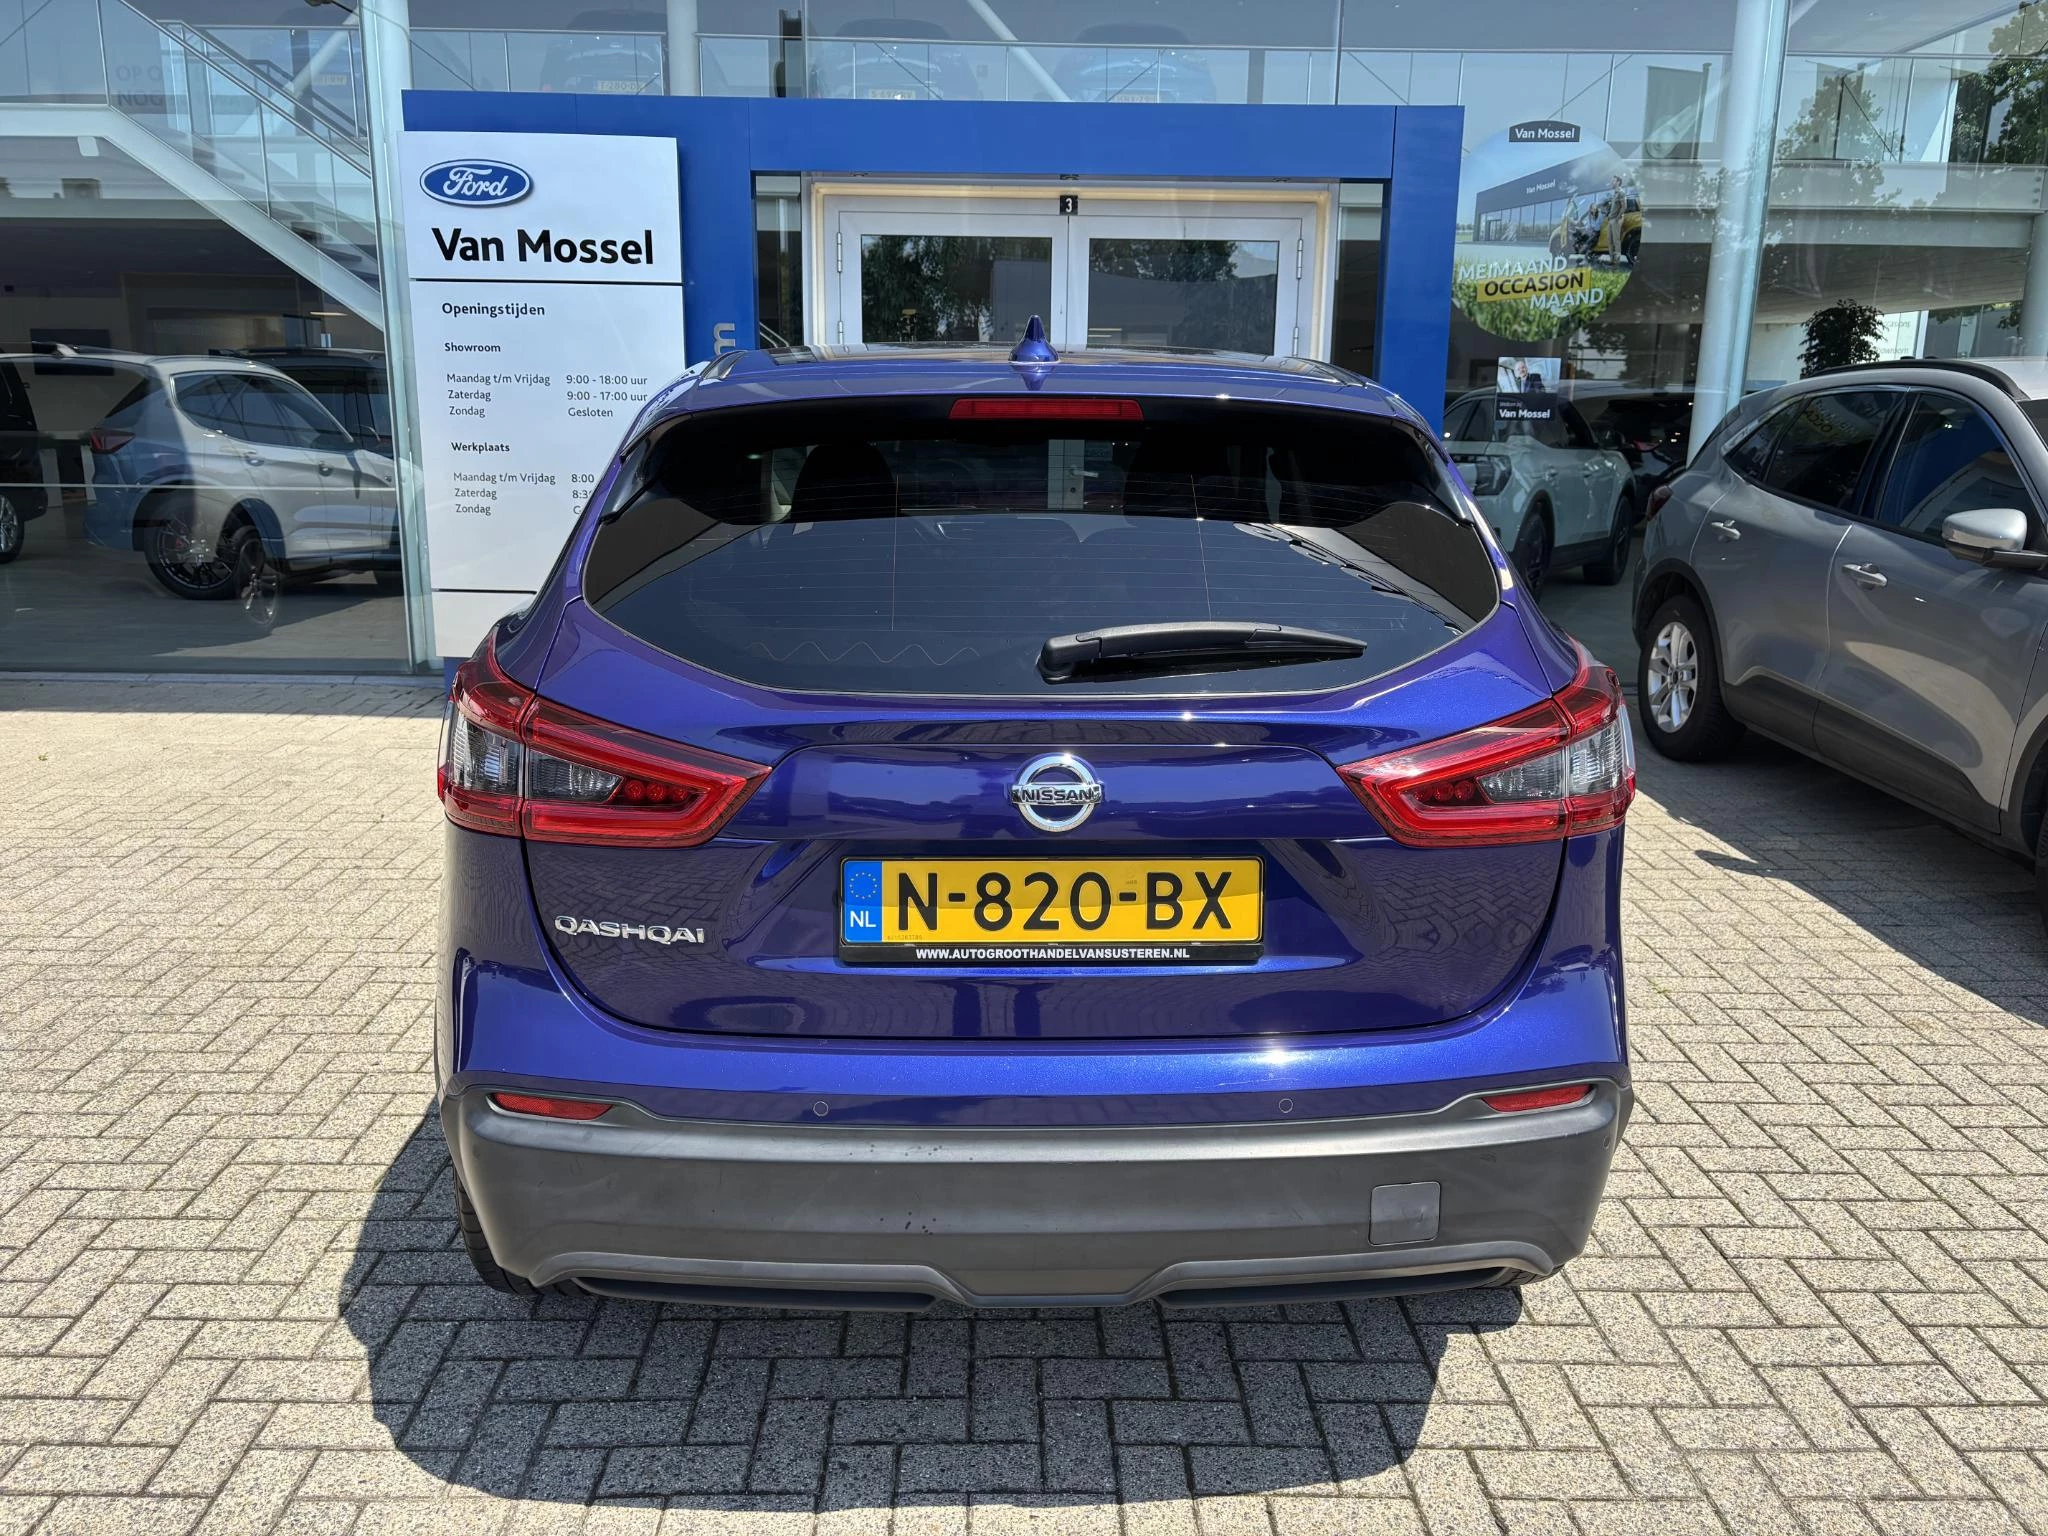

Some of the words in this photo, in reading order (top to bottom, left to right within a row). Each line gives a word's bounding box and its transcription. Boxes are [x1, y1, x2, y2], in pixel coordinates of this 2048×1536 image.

[1515, 129, 1534, 138] Van
[1538, 128, 1574, 138] Mossel
[443, 166, 509, 196] Ford
[1066, 198, 1072, 212] 3
[432, 228, 504, 261] Van
[517, 229, 653, 264] Mossel
[1459, 256, 1567, 281] MEIMAAND
[1484, 272, 1584, 297] OCCASION
[1529, 288, 1605, 310] MAAND
[442, 303, 544, 318] Openingstijden
[445, 342, 500, 352] Showroom
[447, 374, 491, 385] Maandag
[494, 374, 511, 383] t/m
[514, 374, 550, 386] Vrijdag
[566, 375, 589, 384] 9:00
[600, 376, 627, 384] 18:00
[448, 390, 491, 402] Zaterdag
[567, 391, 590, 400] 9:00
[600, 392, 627, 401] 17:00
[450, 406, 485, 418] Zondag
[568, 407, 613, 417] Gesloten
[1499, 409, 1516, 417] Van
[1519, 409, 1550, 418] Mossel
[451, 442, 510, 454] Werkplaats
[454, 472, 497, 484] Maandag
[500, 473, 517, 482] t/m
[520, 473, 555, 485] Vrijdag
[572, 474, 594, 483] 8:00
[455, 488, 497, 500] Zaterdag
[456, 504, 491, 516] Zondag
[1022, 789, 1091, 801] NISSAN
[898, 871, 1232, 931] N-820-BX
[851, 911, 876, 927] NL
[554, 915, 705, 945] QASHQAI
[915, 947, 1190, 959] WWW.AUTOGROOTHANDELVANSUSTEREN.NL
